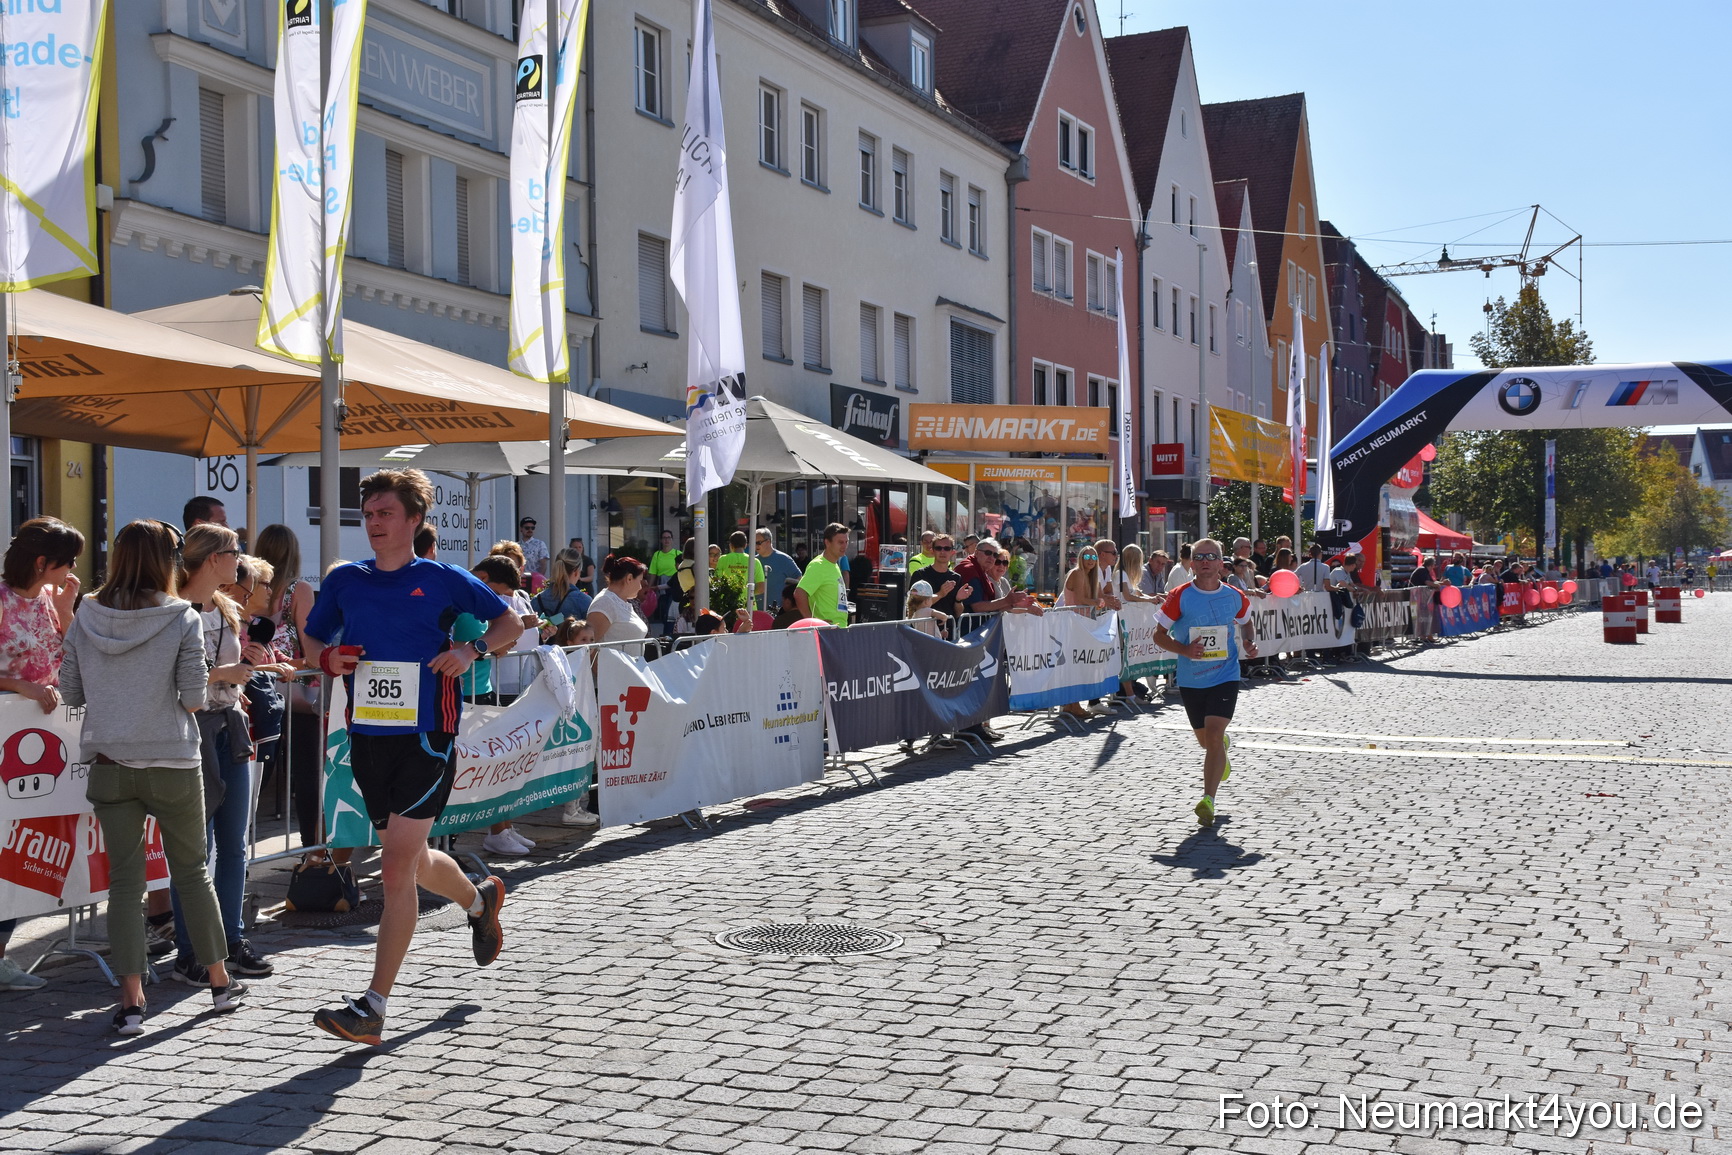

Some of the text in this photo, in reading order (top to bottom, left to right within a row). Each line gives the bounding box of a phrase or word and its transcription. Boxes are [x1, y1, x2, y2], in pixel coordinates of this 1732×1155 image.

[401, 53, 480, 117] WEBER
[915, 416, 1099, 442] RUNMARKT.DE
[1337, 411, 1428, 470] PARTL NEUMARKT
[1156, 454, 1178, 462] WITT
[67, 461, 83, 479] 24
[983, 467, 1055, 479] RUNMARKT.DE
[441, 512, 449, 529] &
[1203, 636, 1216, 646] 73
[1009, 653, 1055, 672] RAIL.ONE
[927, 665, 979, 690] RAIL.ONE
[368, 679, 402, 699] 365
[828, 674, 892, 702] RAIL.ONE
[3, 819, 71, 868] Braun
[23, 861, 44, 874] Sicher
[44, 868, 52, 877] ist
